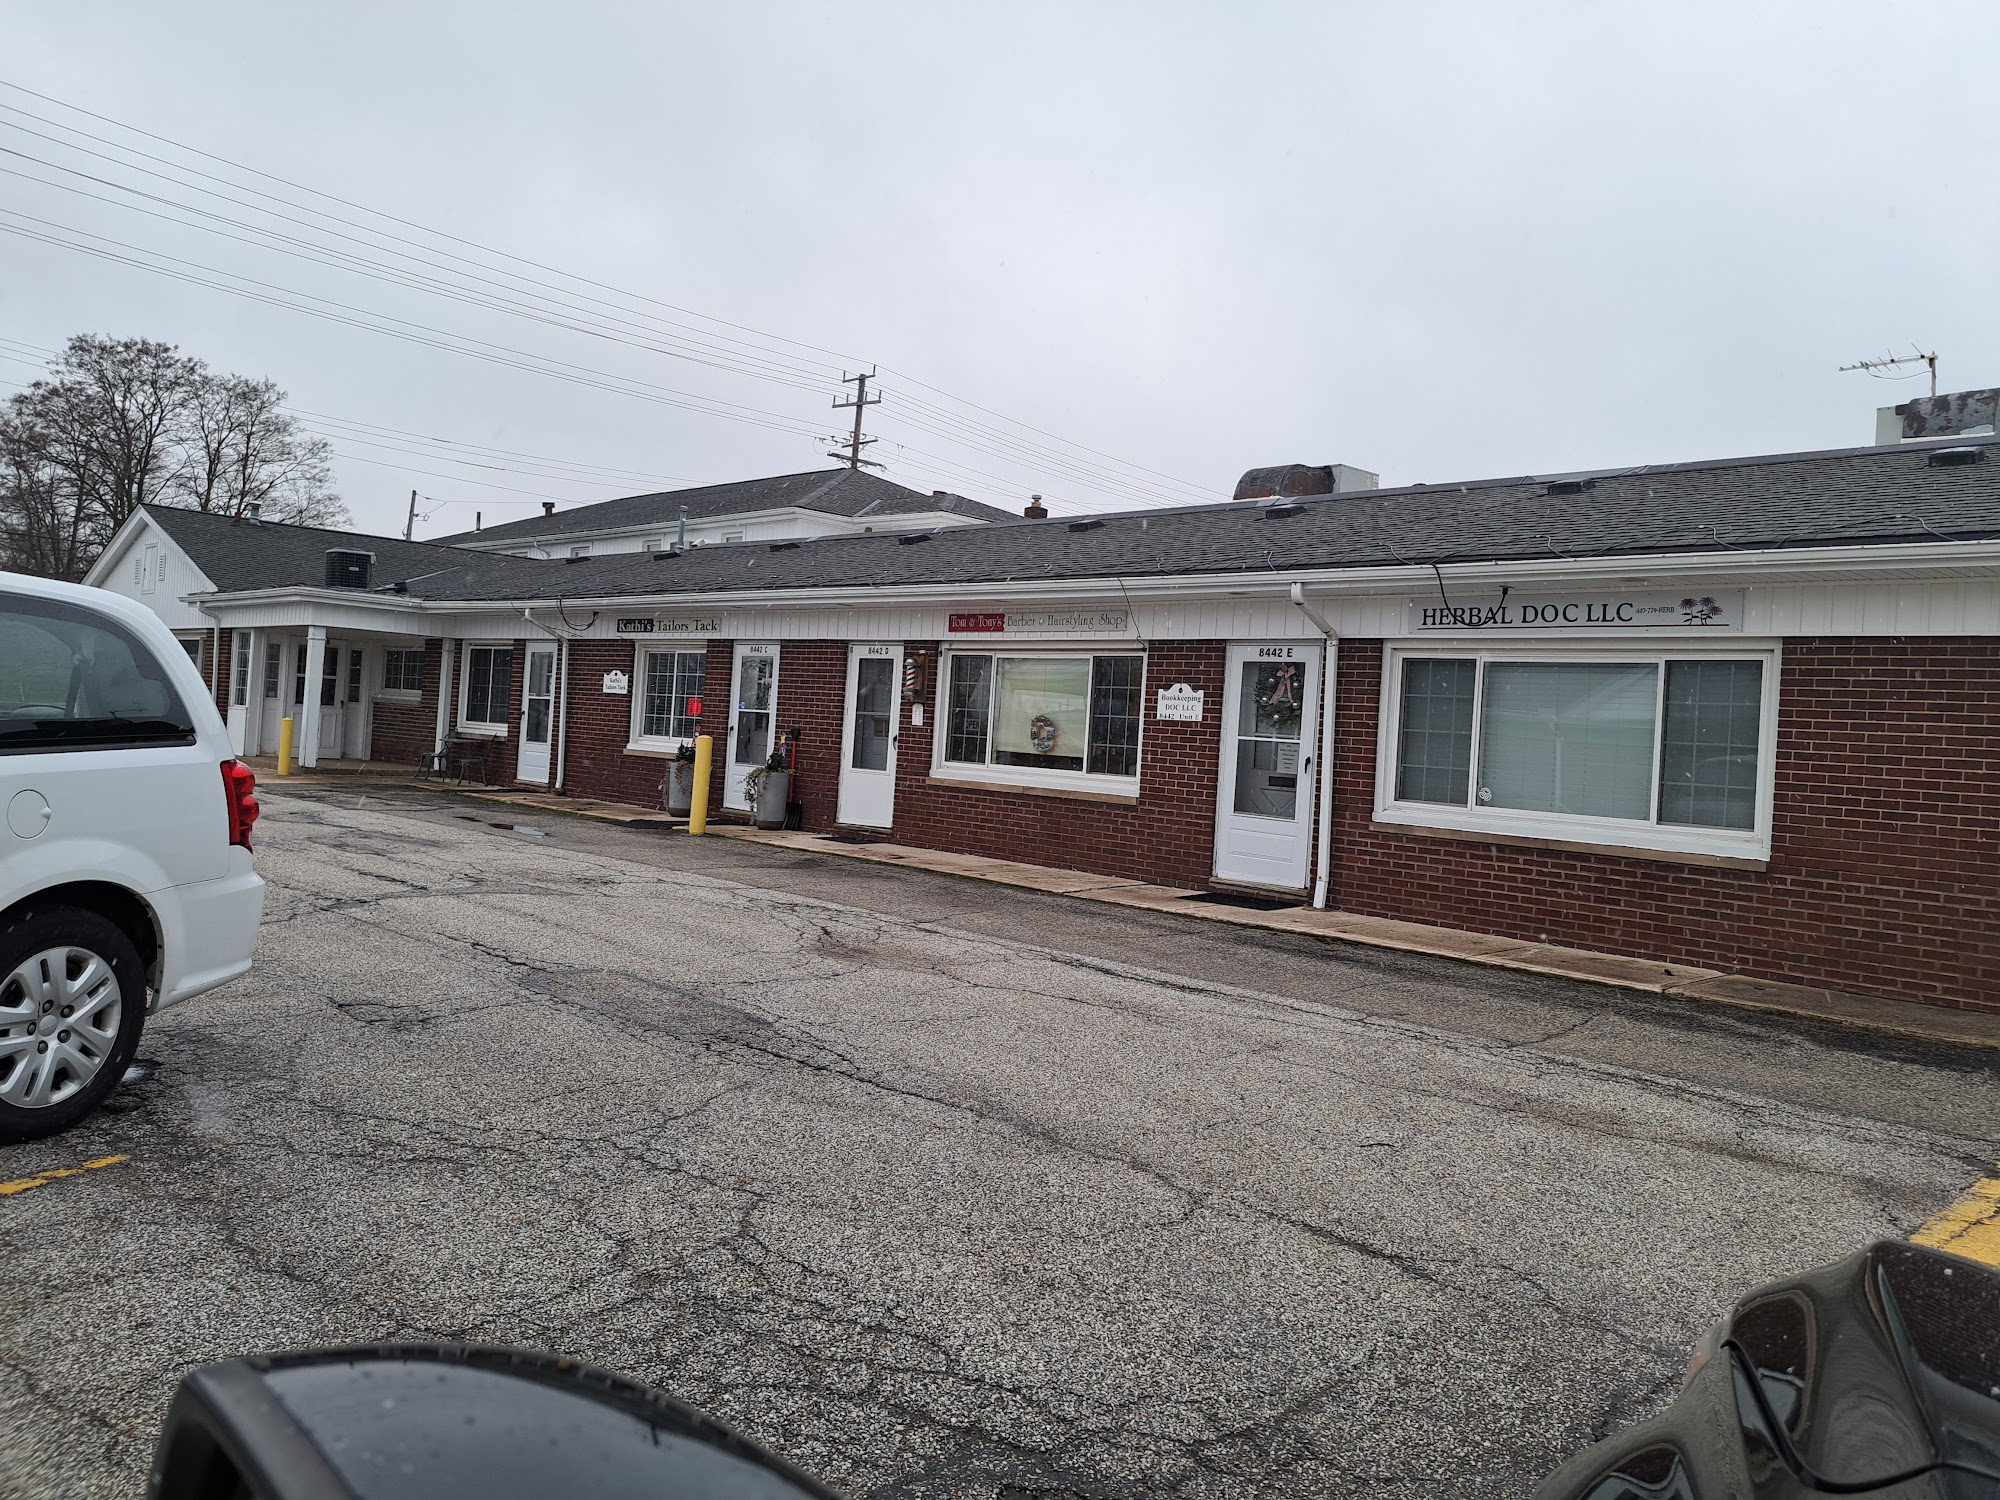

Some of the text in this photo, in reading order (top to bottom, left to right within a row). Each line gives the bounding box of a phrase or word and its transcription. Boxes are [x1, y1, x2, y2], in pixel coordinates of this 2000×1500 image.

[1421, 602, 1634, 626] HERBAL DOC LLC
[618, 619, 718, 632] Kathi's Tailors Tack
[951, 615, 966, 627] Tom
[968, 617, 975, 627] &
[977, 614, 1002, 631] Tony's
[1007, 613, 1037, 627] Barber
[1047, 613, 1094, 630] Hairstyling
[1098, 613, 1123, 629] Shop
[868, 647, 883, 655] 8442
[1258, 647, 1293, 658] 8442 E
[1161, 694, 1202, 703] Bookkeeping
[1165, 703, 1181, 711] DOC
